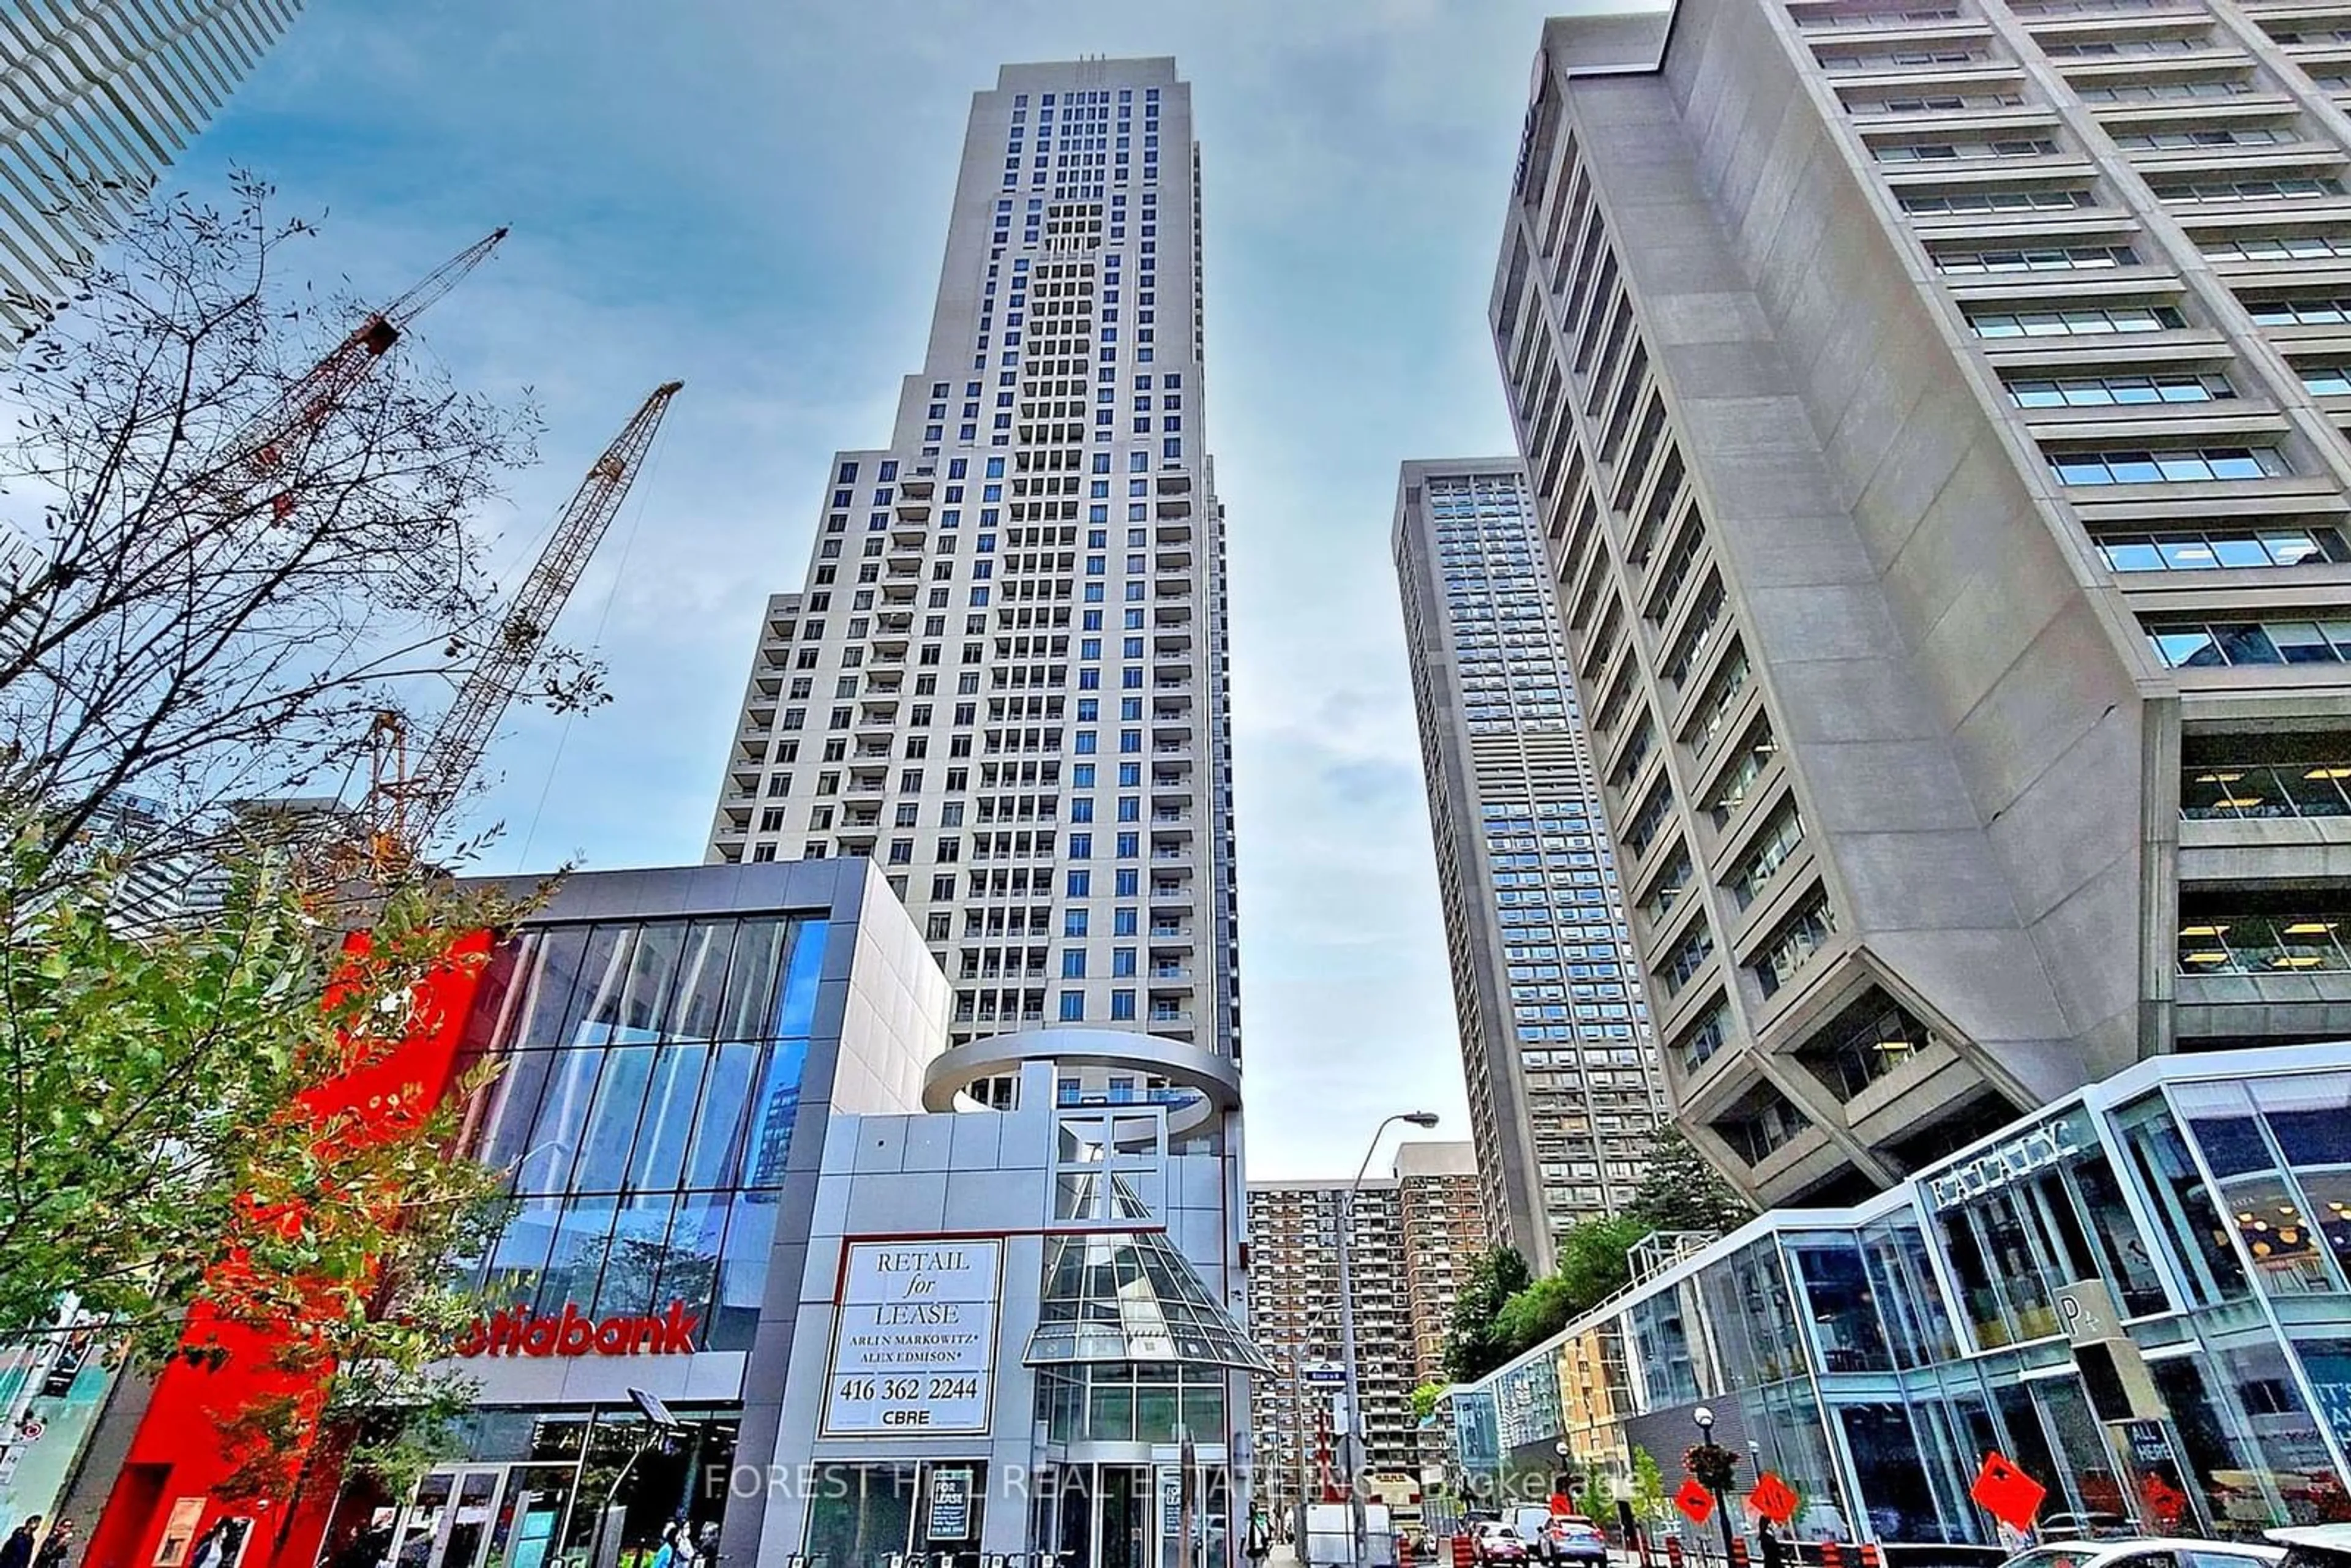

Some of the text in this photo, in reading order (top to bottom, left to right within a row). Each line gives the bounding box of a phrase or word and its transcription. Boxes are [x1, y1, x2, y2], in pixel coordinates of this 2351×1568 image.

[1929, 1120, 2079, 1210] EATALY
[877, 1251, 971, 1272] RETAIL
[902, 1272, 936, 1299] for
[875, 1304, 959, 1326] LEASE
[454, 1298, 700, 1358] otiabank
[849, 1336, 891, 1346] ARLIN
[861, 1352, 894, 1364] ALEX
[840, 1378, 978, 1401] 416 362 2244
[882, 1410, 931, 1425] CBRE
[936, 1482, 956, 1493] FOR
